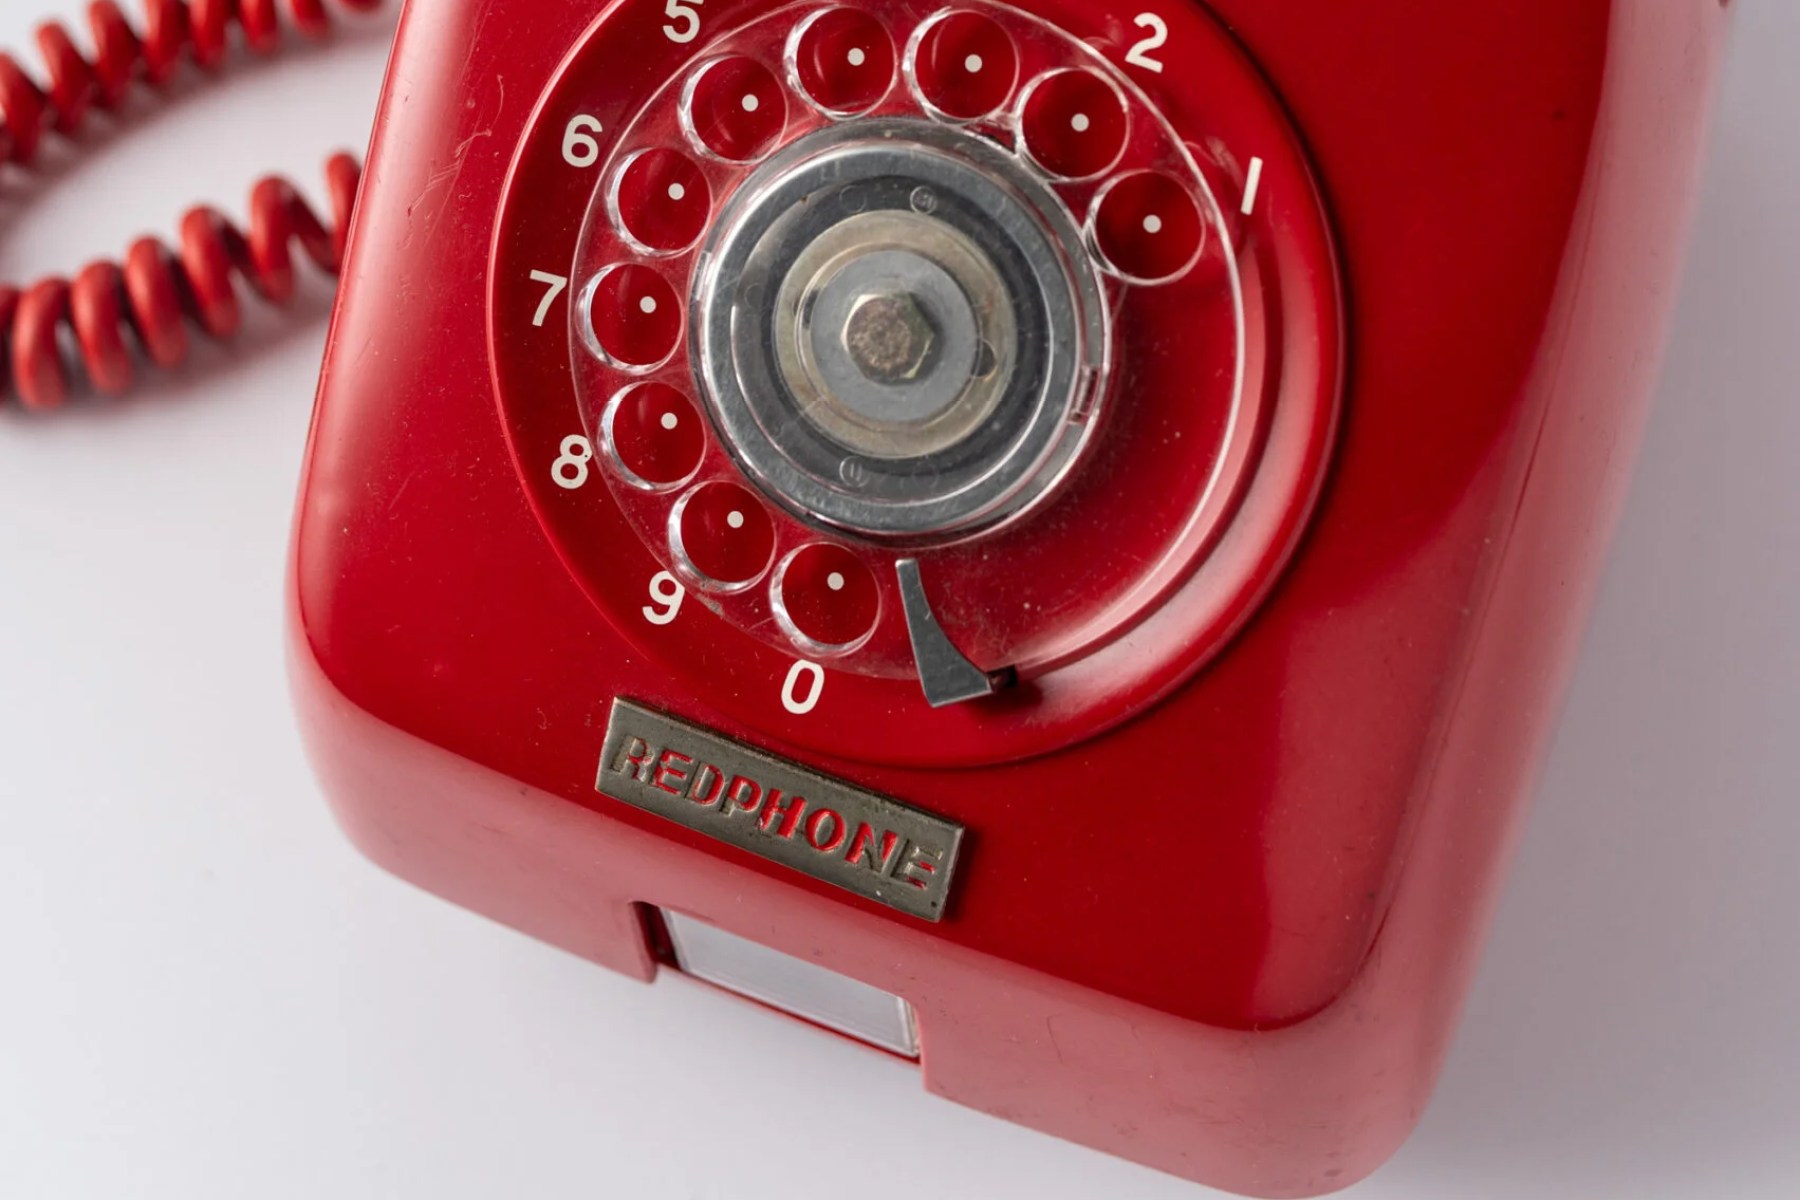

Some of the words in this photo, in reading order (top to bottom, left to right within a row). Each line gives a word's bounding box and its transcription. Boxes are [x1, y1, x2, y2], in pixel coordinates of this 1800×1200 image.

[1125, 12, 1168, 73] 2
[562, 114, 603, 167] 6
[1241, 157, 1263, 215] 1
[530, 270, 567, 327] 7
[551, 434, 593, 489] 8
[642, 570, 686, 625] 9
[781, 659, 825, 714] 0
[609, 736, 943, 890] REDPHONE
